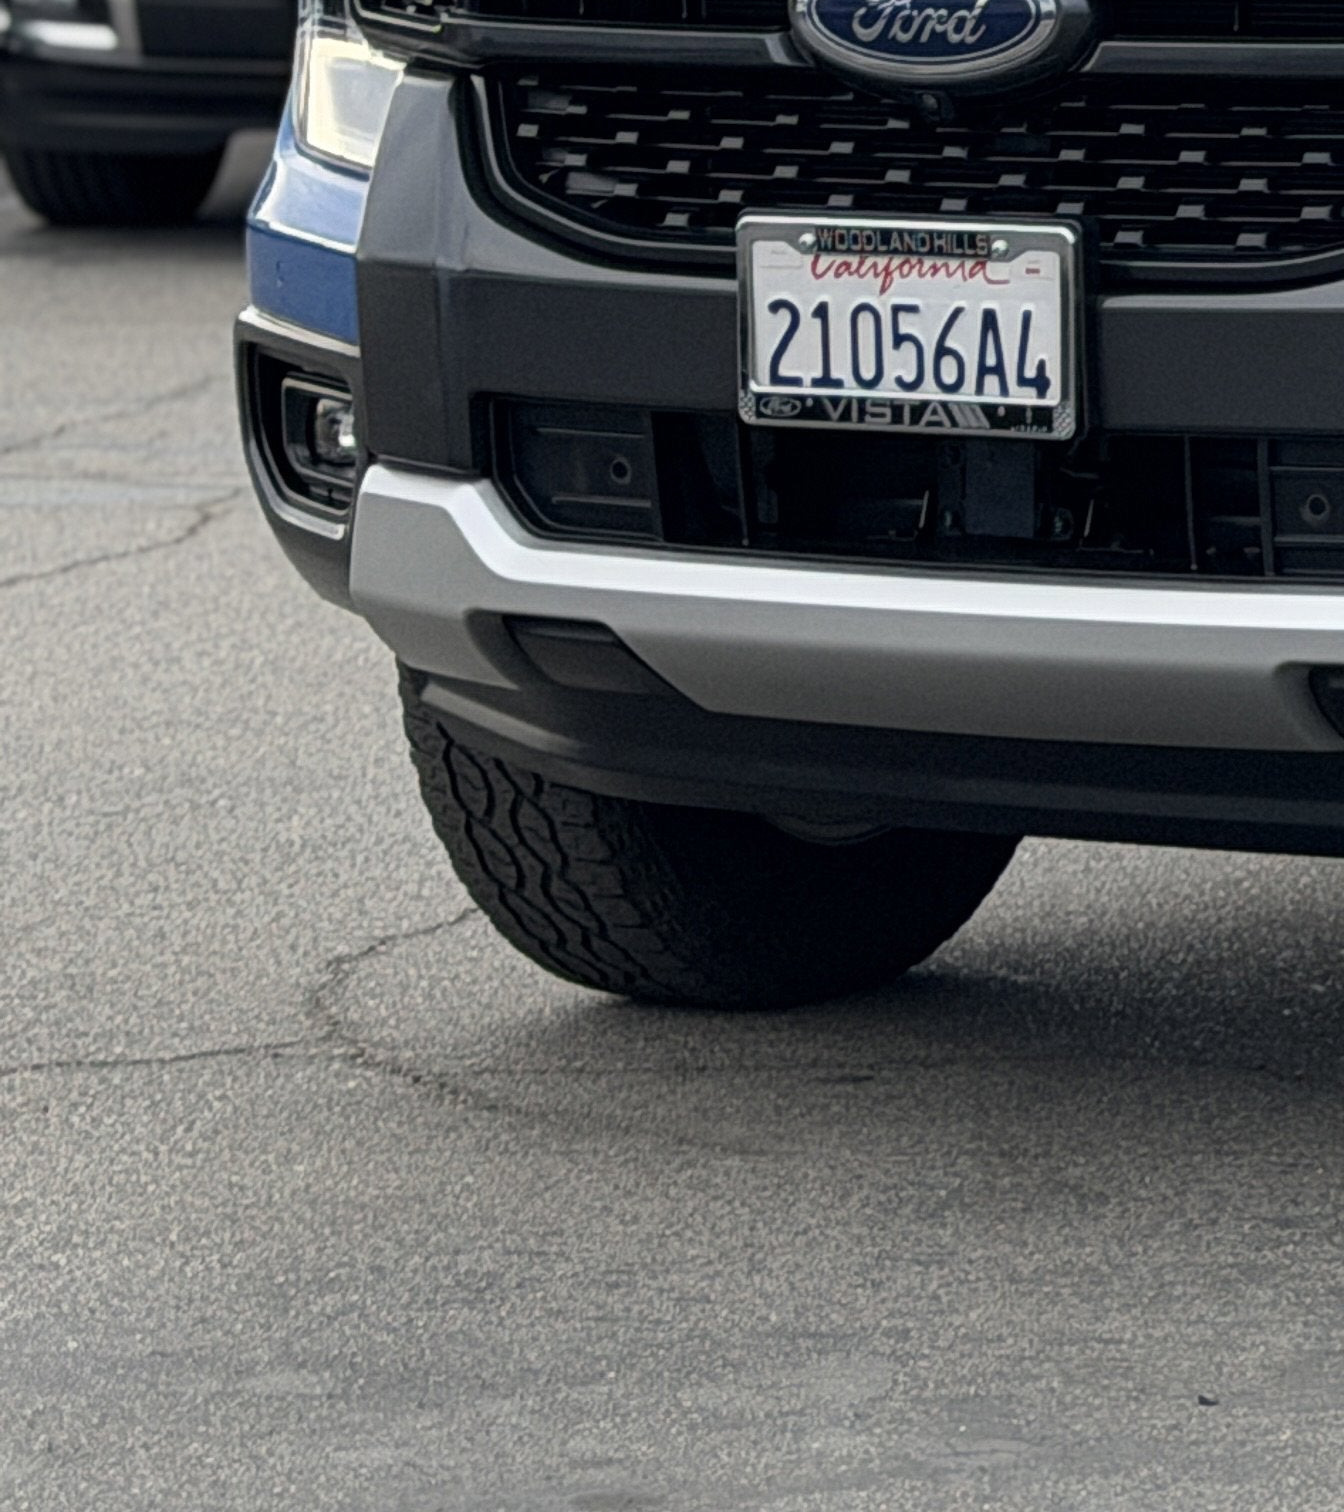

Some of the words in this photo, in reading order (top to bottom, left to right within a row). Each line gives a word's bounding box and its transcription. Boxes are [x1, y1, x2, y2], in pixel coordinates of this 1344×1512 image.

[817, 229, 930, 254] WOODLAND
[932, 232, 989, 256] HILLS
[811, 252, 1009, 296] California
[767, 298, 1051, 400] 21056A4
[821, 397, 953, 429] VISTA
